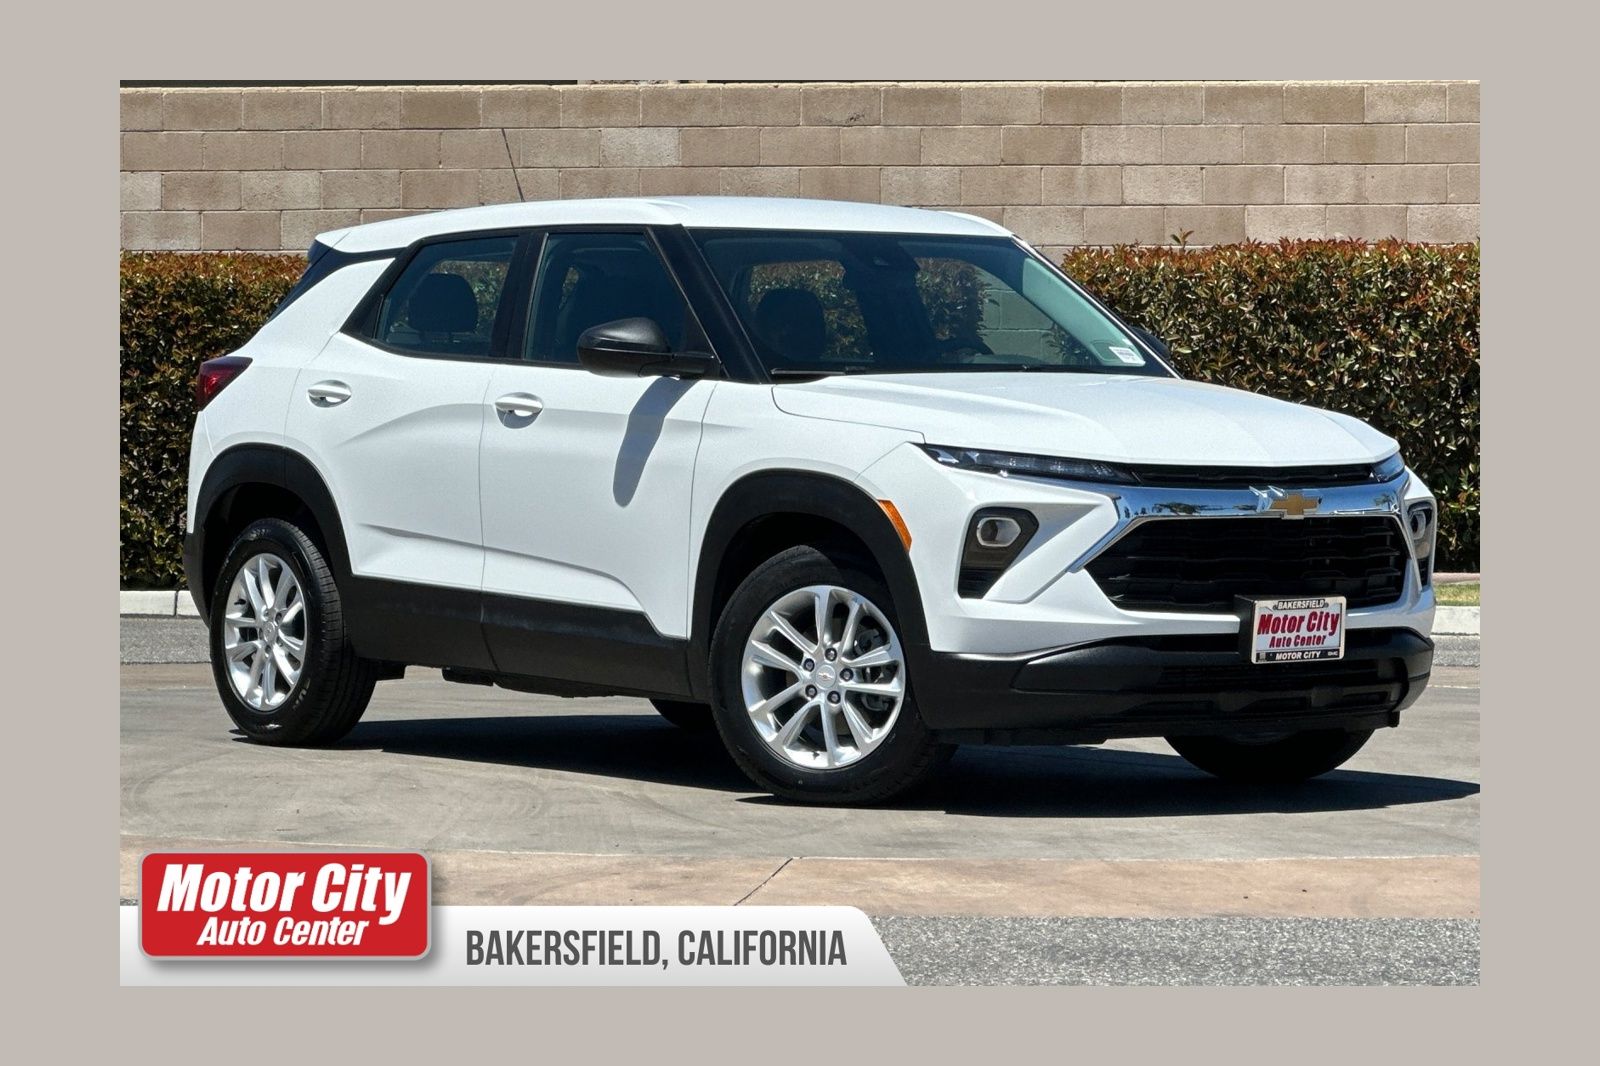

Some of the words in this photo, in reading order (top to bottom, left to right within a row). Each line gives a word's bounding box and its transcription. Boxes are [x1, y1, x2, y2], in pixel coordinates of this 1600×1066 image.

[1278, 600, 1324, 609] BAKERSFIELD
[1257, 614, 1304, 635] Motor
[1306, 611, 1340, 636] City
[1269, 636, 1292, 648] Auto
[1294, 635, 1326, 647] Center
[1275, 652, 1302, 660] MOTOR
